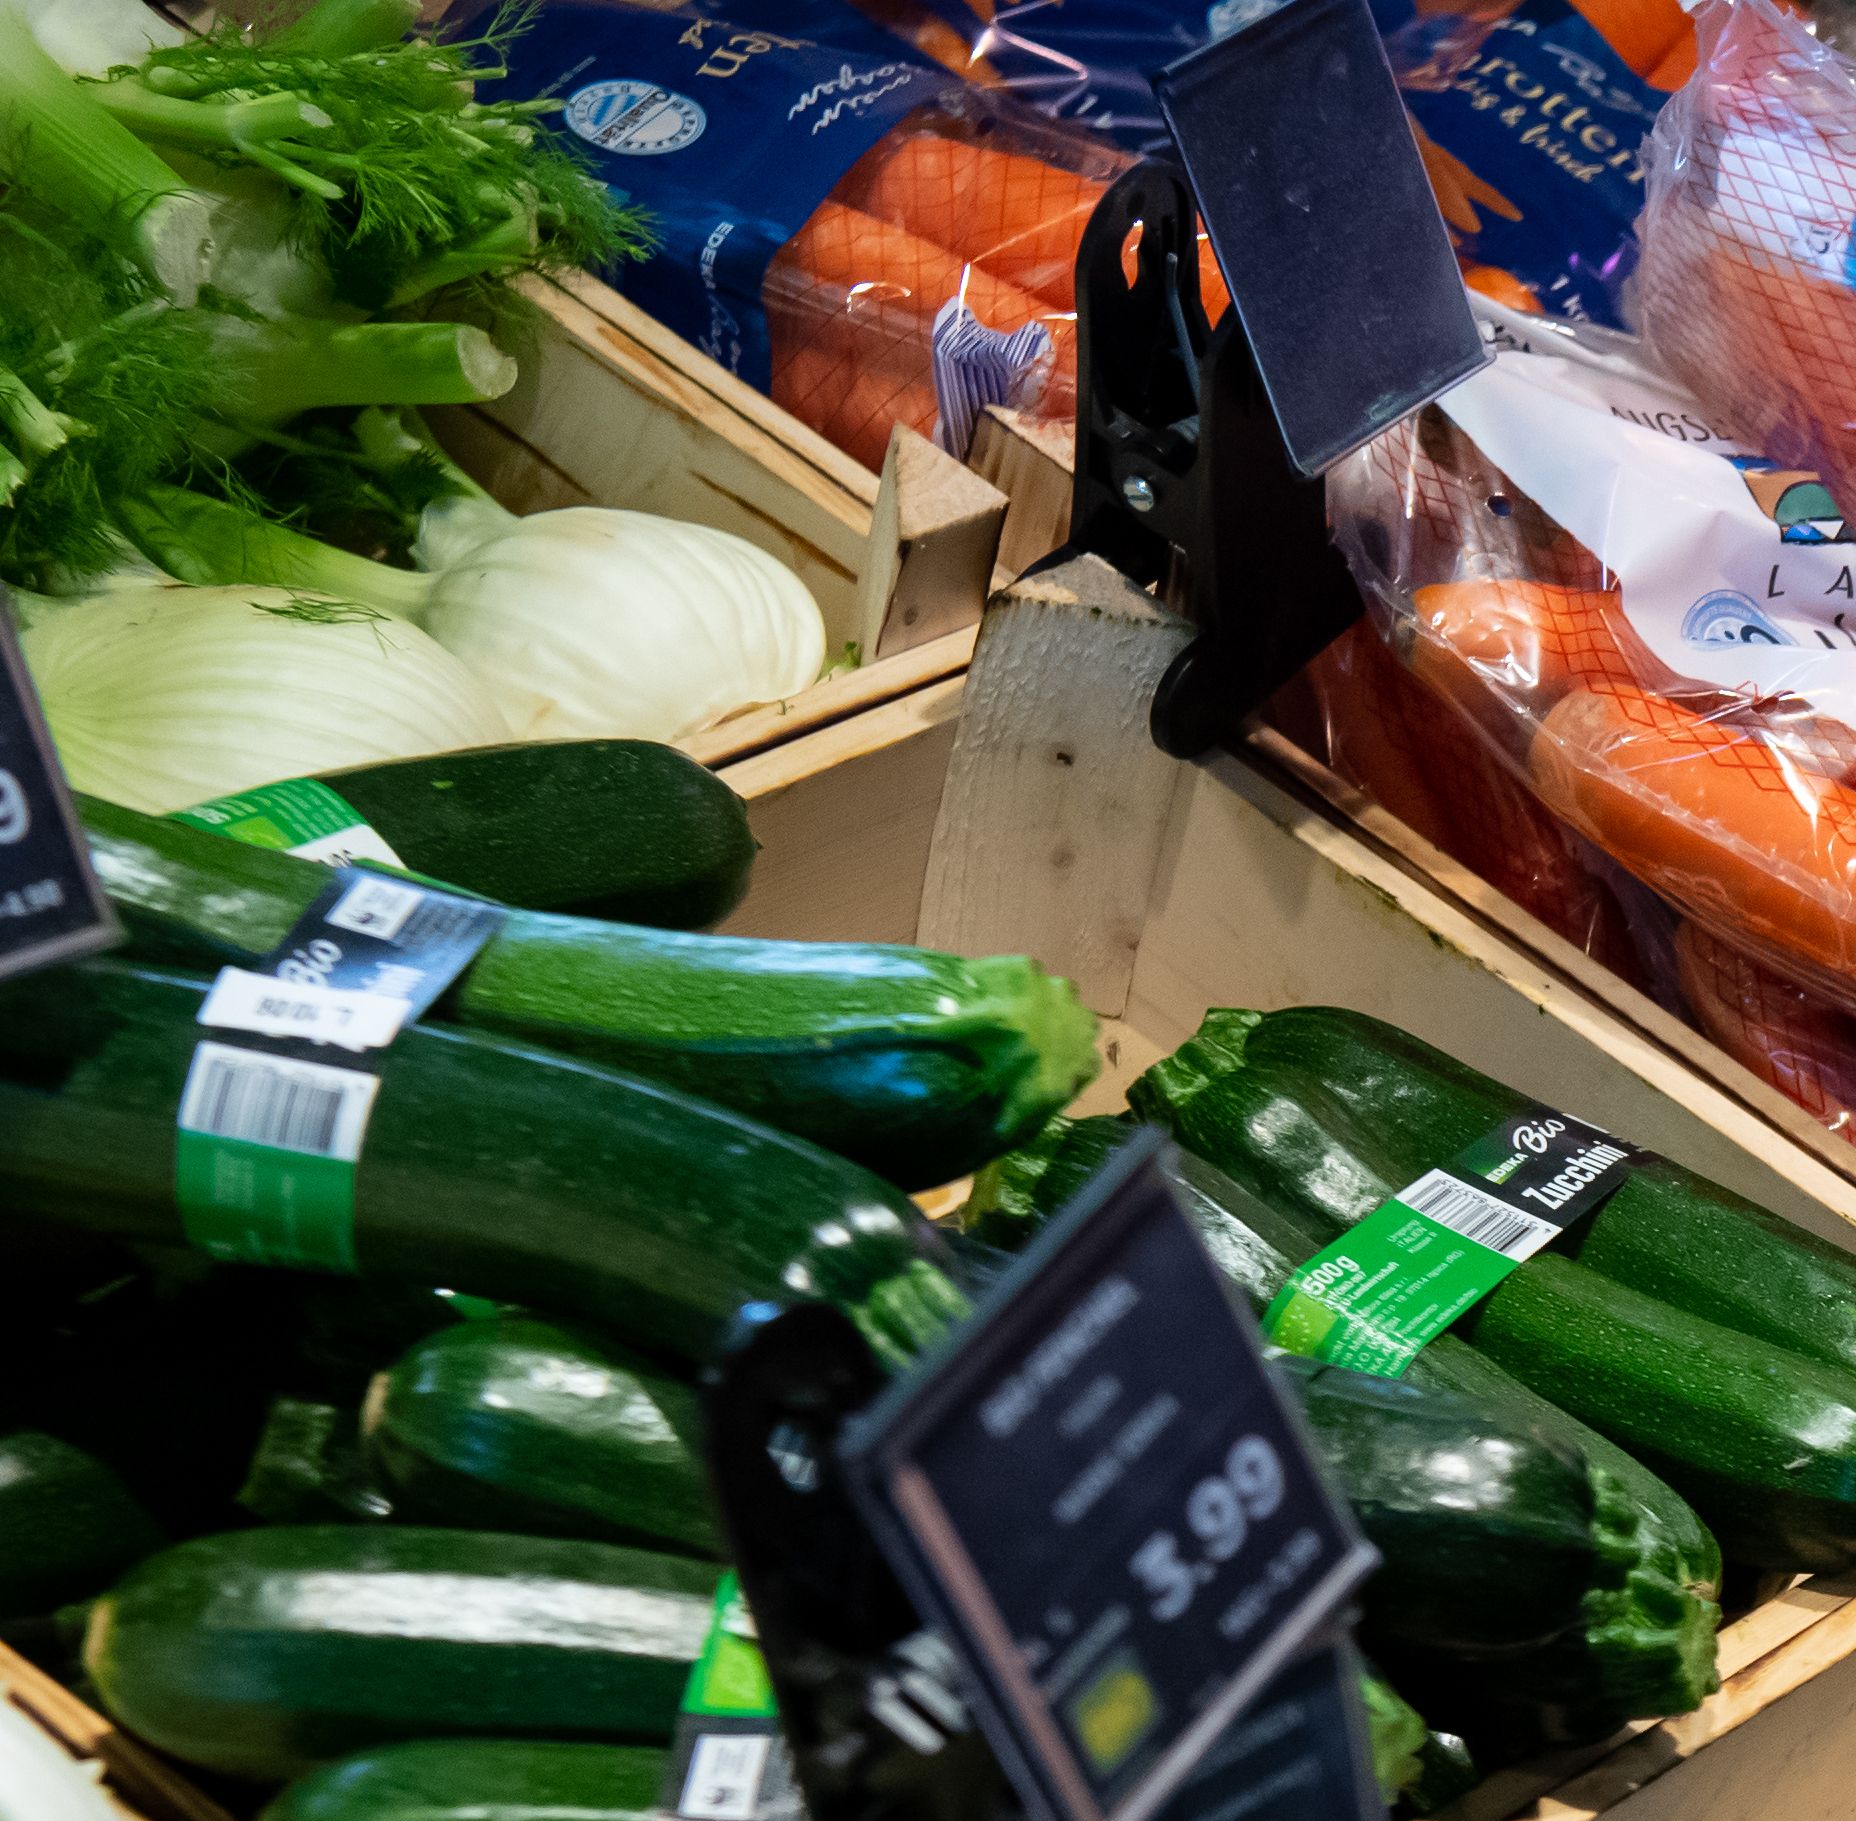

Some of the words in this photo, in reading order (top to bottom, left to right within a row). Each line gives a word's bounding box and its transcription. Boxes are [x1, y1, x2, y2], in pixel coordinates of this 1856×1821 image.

[1484, 1152, 1528, 1184] EDEKA
[1512, 1118, 1567, 1155] Bio
[1521, 1141, 1629, 1211] Zucchini
[1130, 1434, 1286, 1622] 3.99
